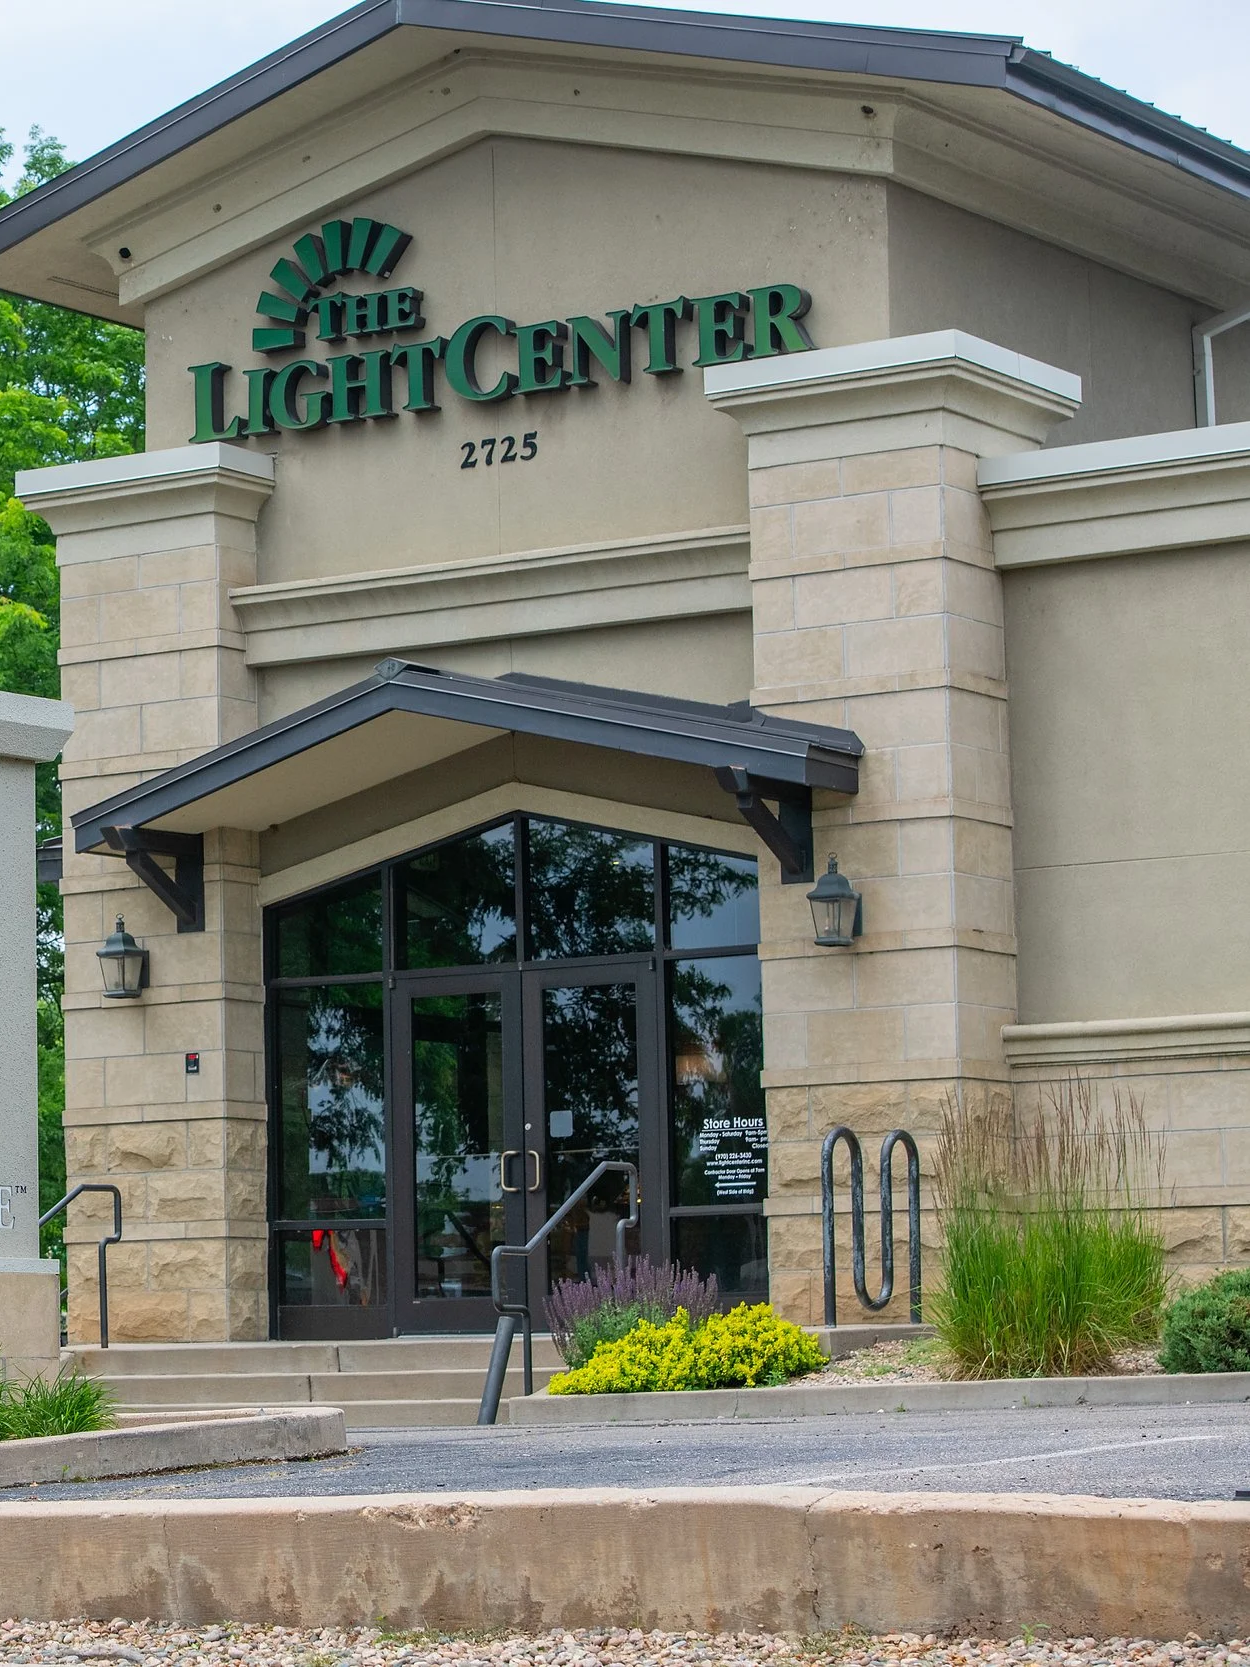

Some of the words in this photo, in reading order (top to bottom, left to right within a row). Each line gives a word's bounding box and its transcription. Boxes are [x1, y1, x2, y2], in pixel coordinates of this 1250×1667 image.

[307, 286, 424, 343] THE
[460, 430, 538, 470] 2725
[699, 1131, 719, 1139] Monday
[722, 1130, 743, 1138] Saturday
[703, 1118, 730, 1129] Store
[733, 1117, 763, 1127] Hours
